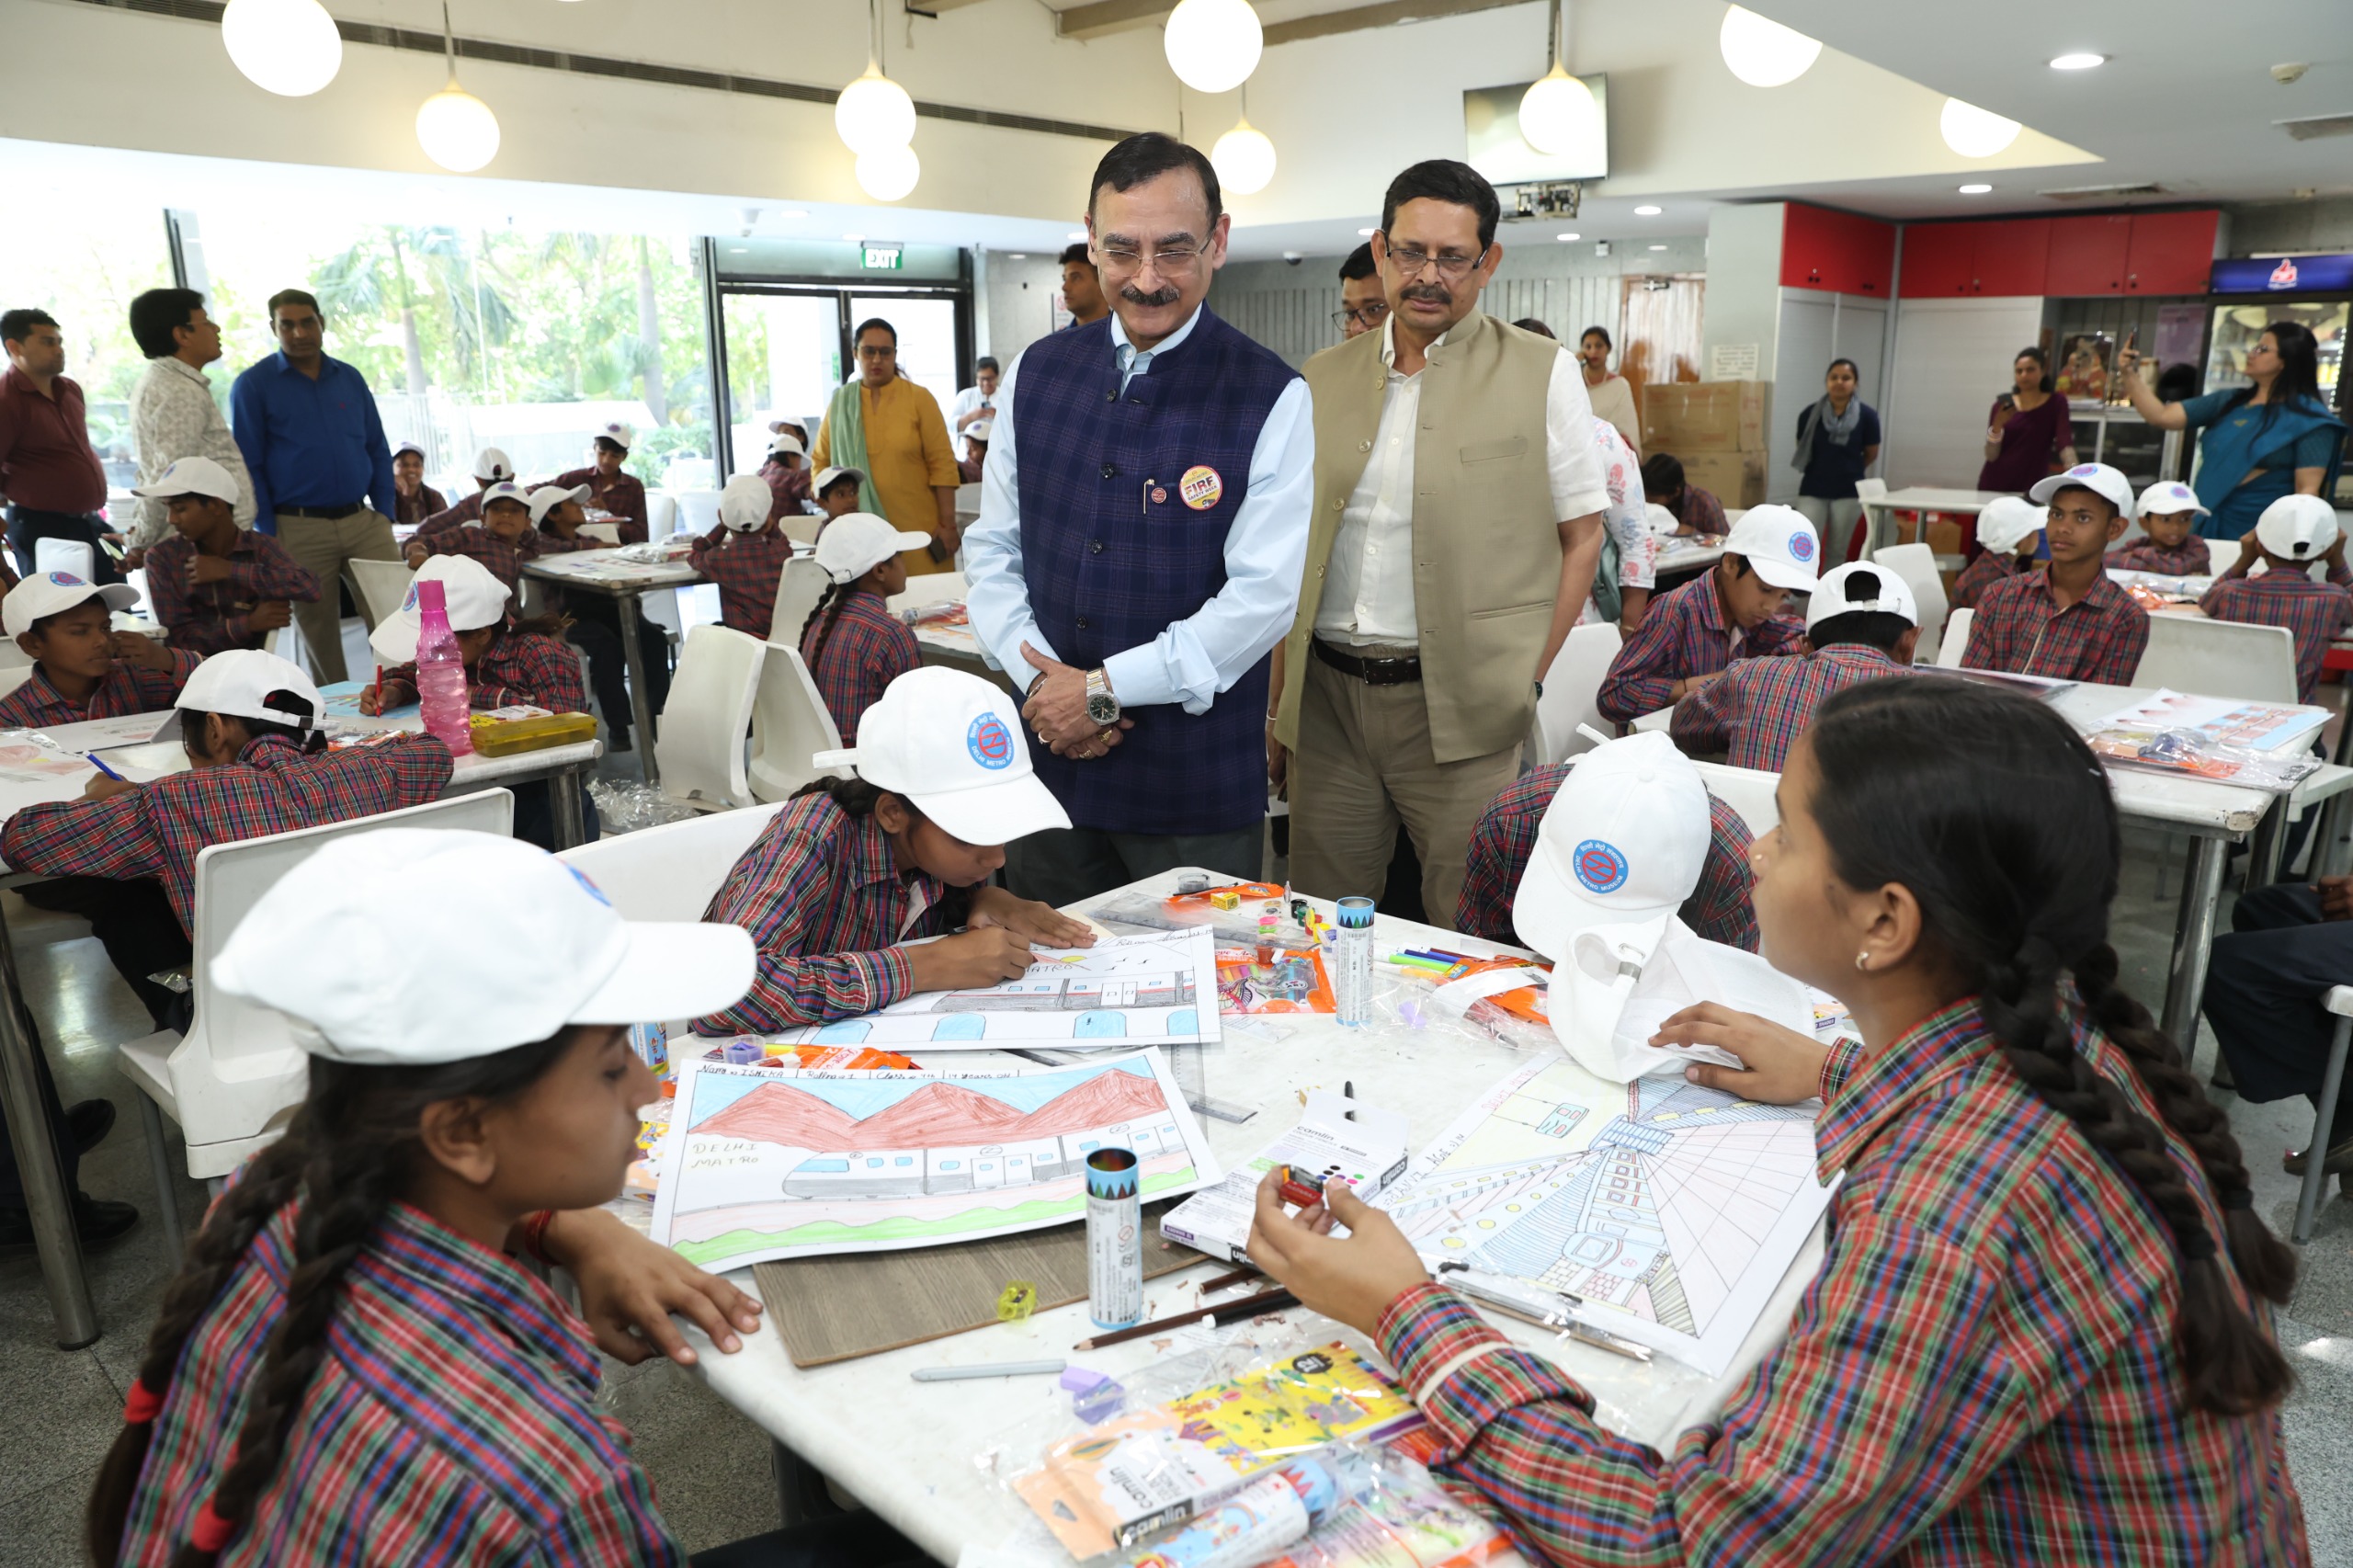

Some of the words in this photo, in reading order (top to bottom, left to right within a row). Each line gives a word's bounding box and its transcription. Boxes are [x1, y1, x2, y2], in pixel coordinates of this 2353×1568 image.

[866, 248, 899, 268] EXIT
[1188, 491, 1204, 501] SAFETY
[972, 745, 986, 763] DELHI
[1580, 874, 1599, 890] METRO
[1600, 875, 1624, 892] MUSEUM
[741, 1069, 784, 1078] ISHIKA
[1296, 1125, 1335, 1142] camlin
[693, 1142, 757, 1153] DELHI
[691, 1155, 759, 1168] MATRO
[1382, 1161, 1405, 1185] camlin
[1233, 1250, 1253, 1263] mlin
[1297, 1355, 1325, 1372] 12
[1109, 1465, 1154, 1509] camlin
[1121, 1505, 1187, 1542] camlin
